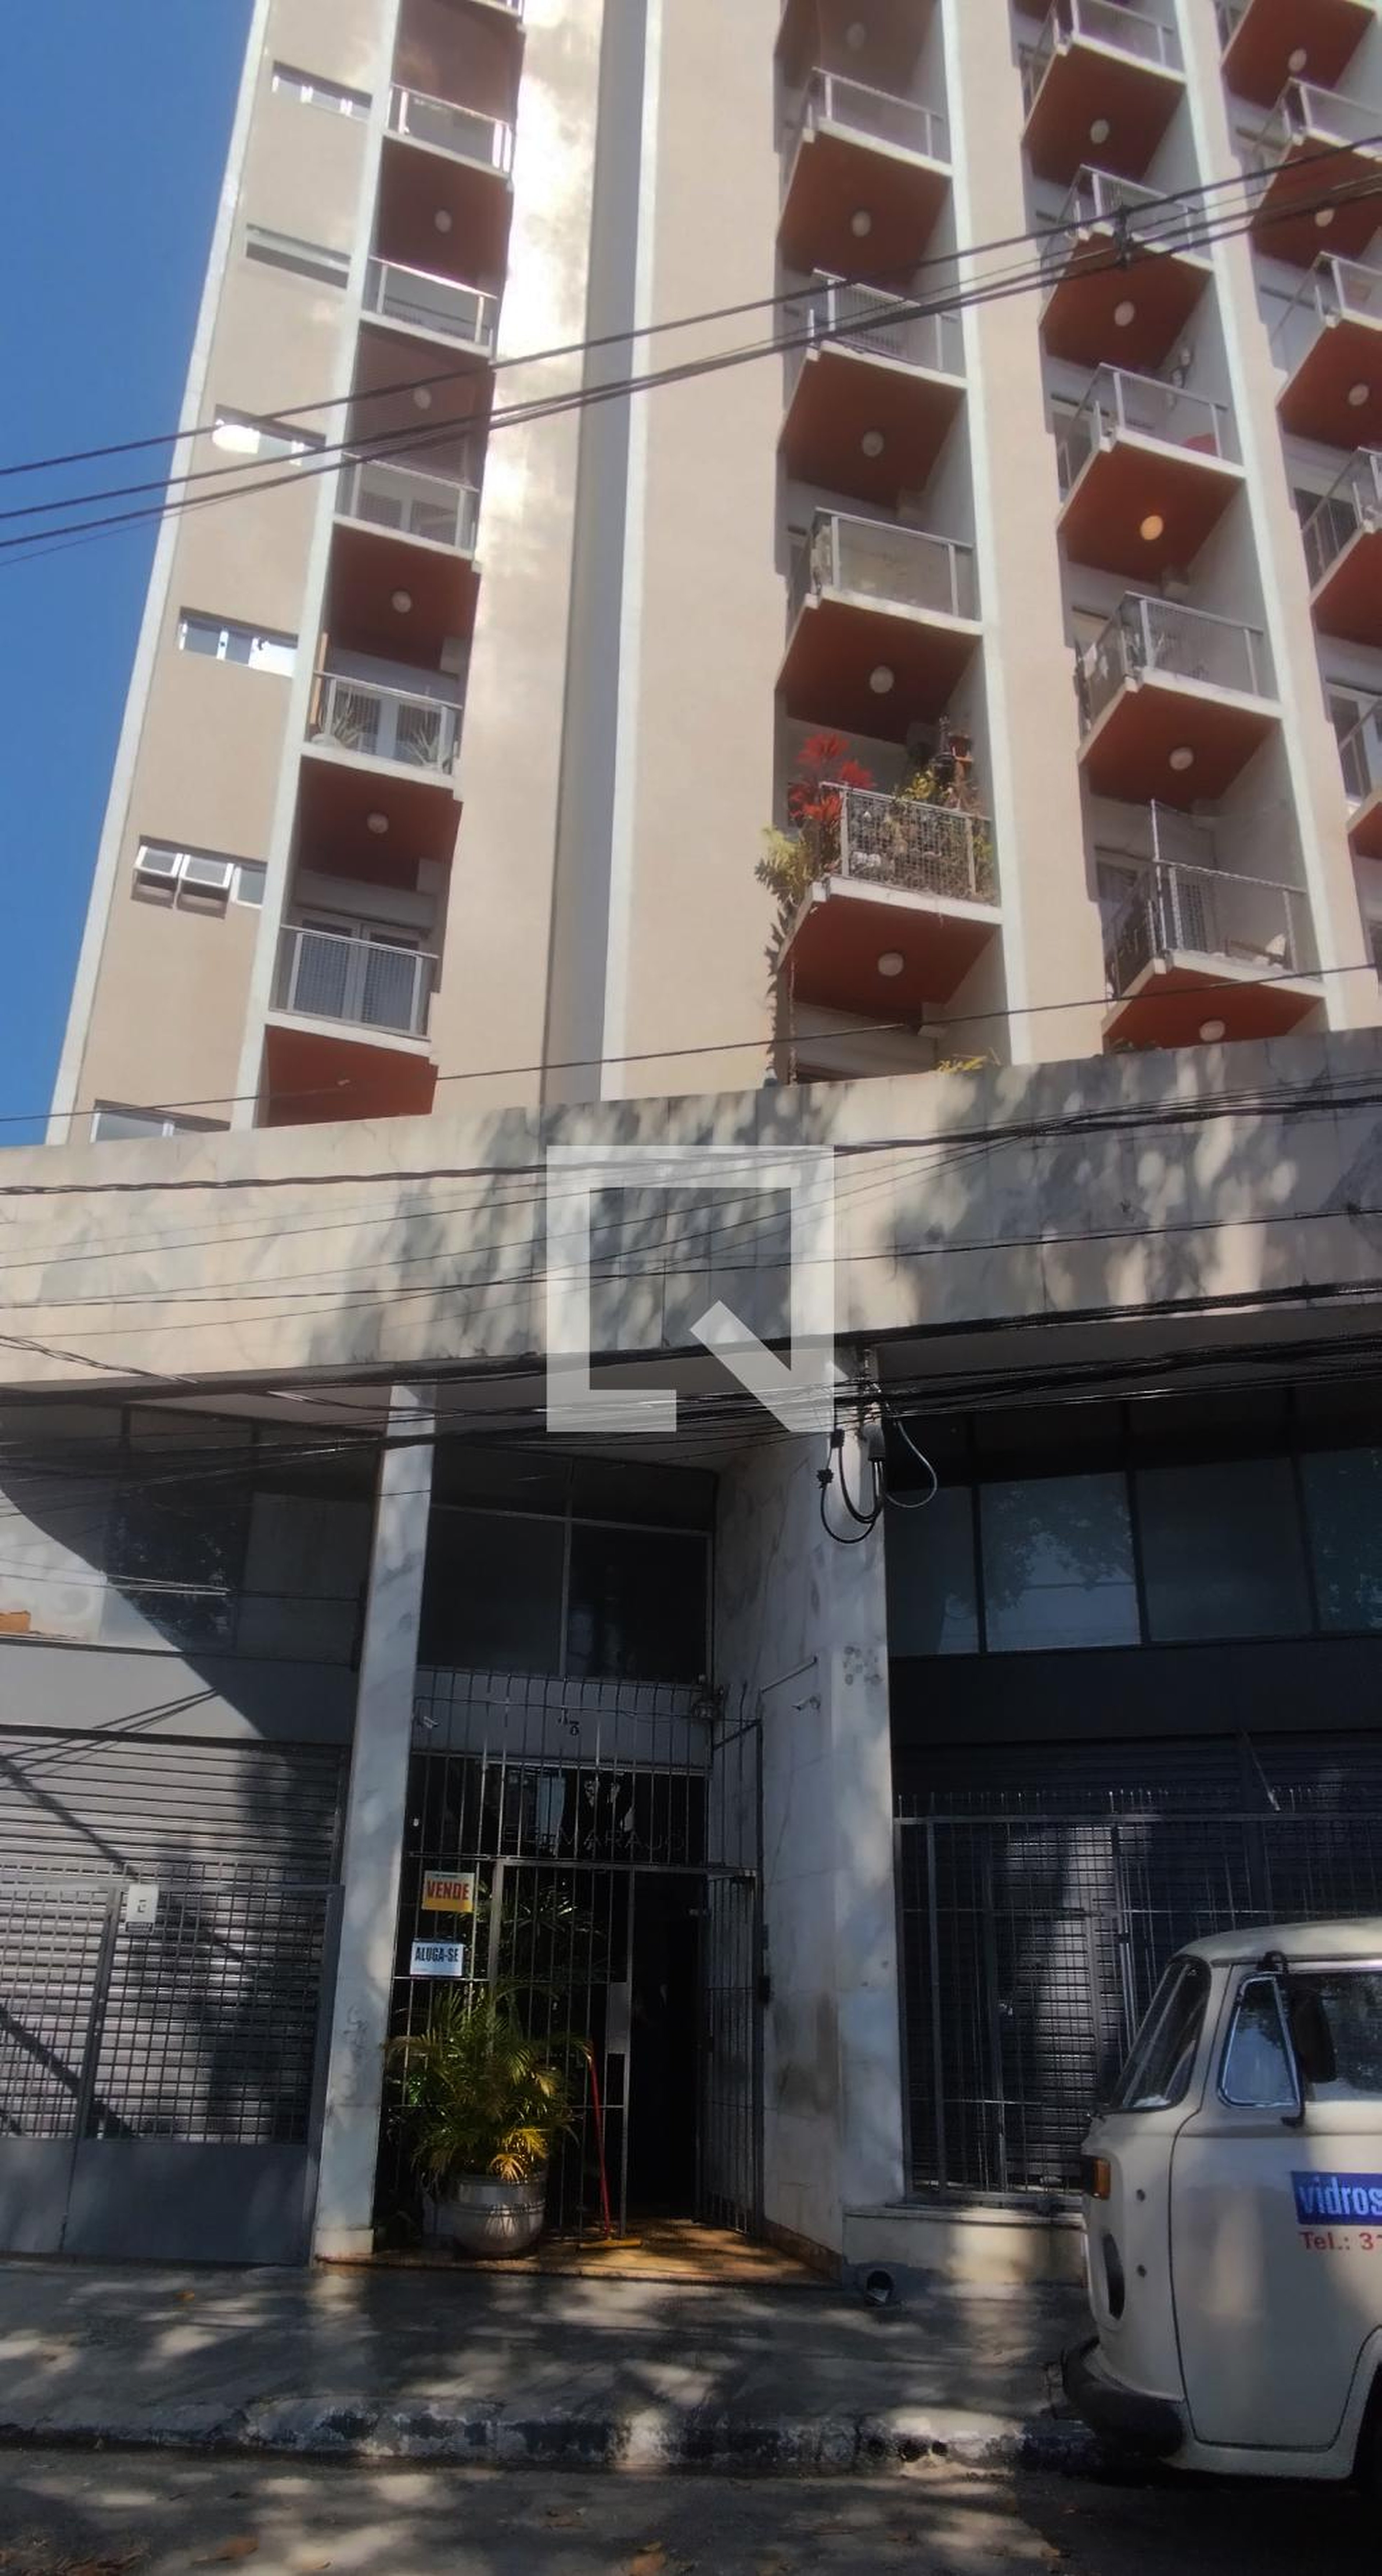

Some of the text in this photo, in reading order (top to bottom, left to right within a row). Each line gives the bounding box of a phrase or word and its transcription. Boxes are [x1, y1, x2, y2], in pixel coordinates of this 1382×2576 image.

[427, 1880, 469, 1900] VENDE
[415, 1947, 459, 1962] ALUGA-SE
[1299, 2176, 1382, 2216] vidros
[1299, 2231, 1350, 2250] Tel.:
